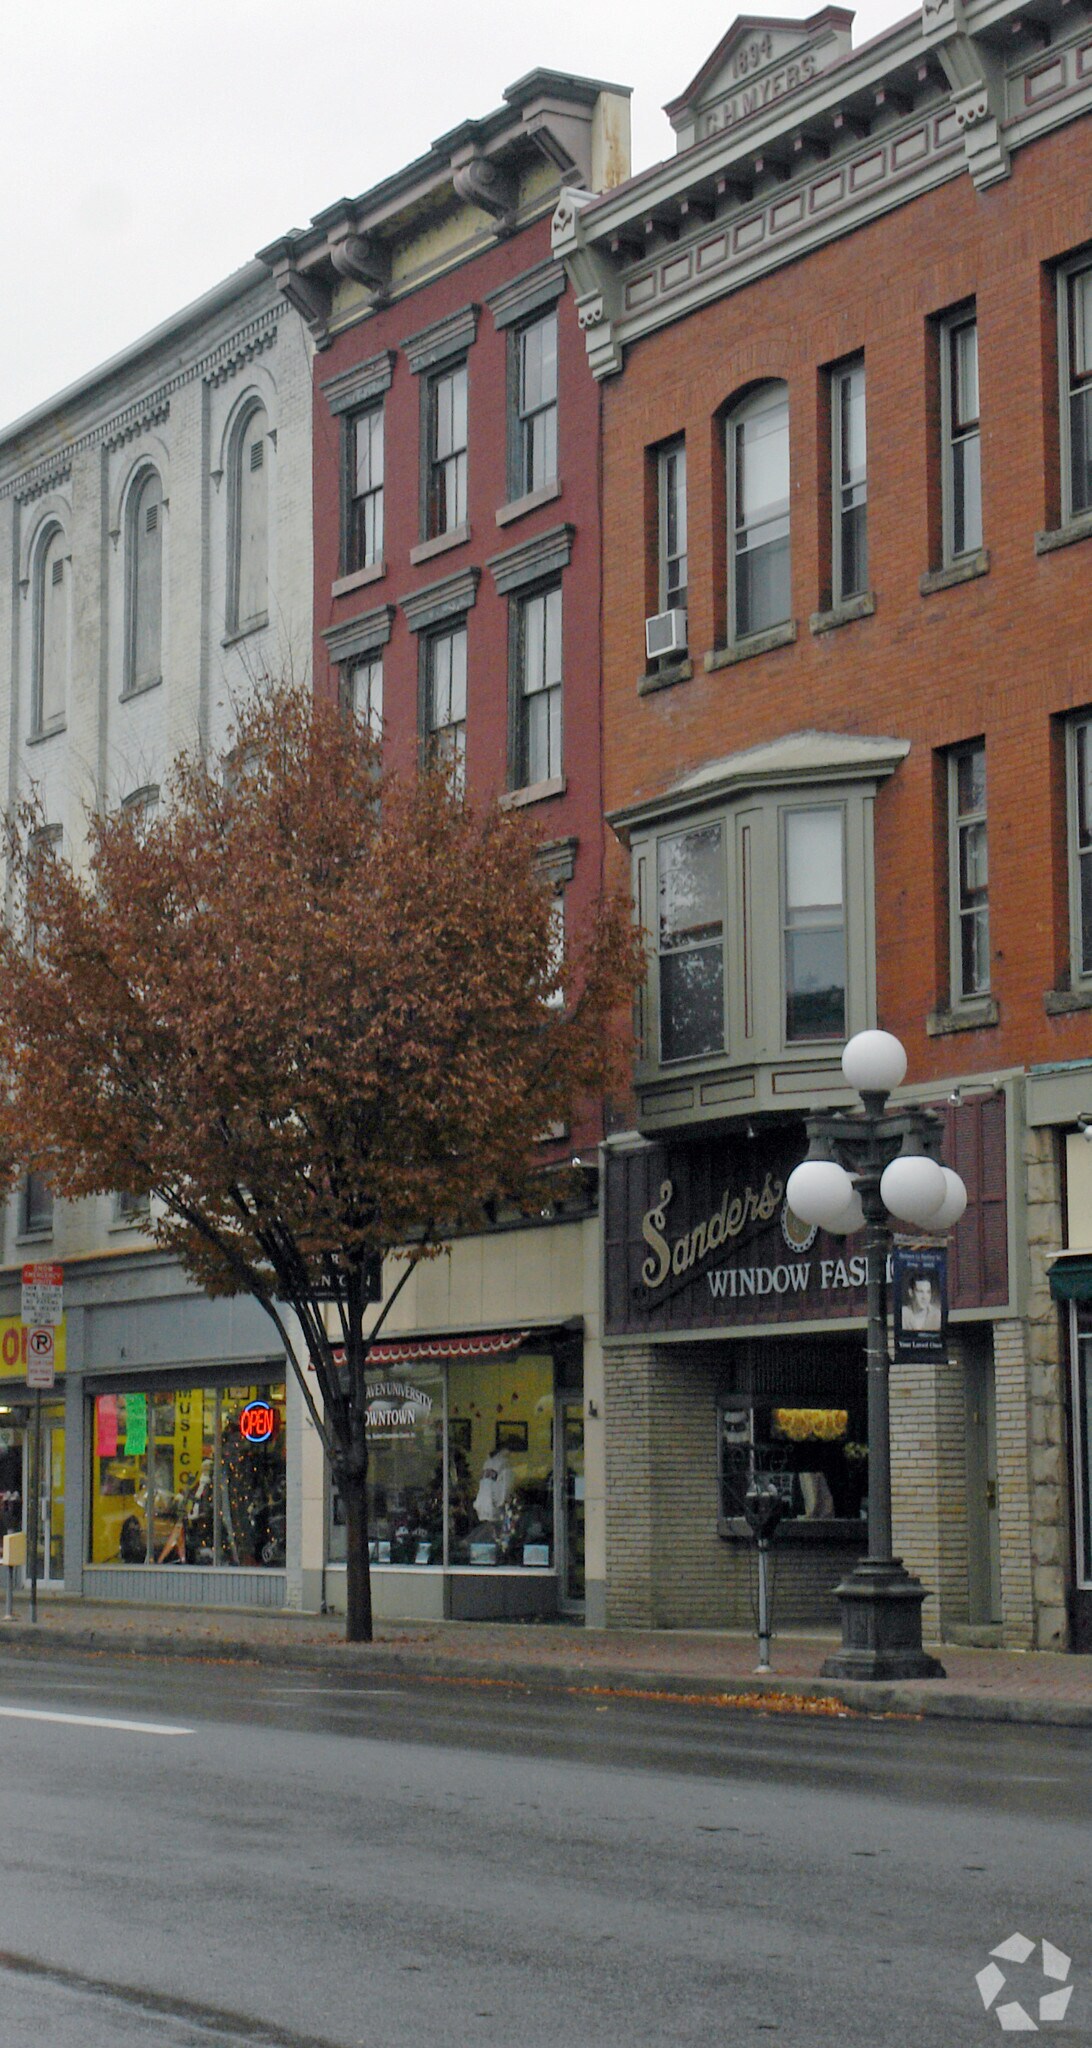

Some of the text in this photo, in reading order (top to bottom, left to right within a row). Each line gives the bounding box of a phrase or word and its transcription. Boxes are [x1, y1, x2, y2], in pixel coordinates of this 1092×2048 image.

[732, 33, 772, 79] 1894
[743, 55, 815, 114] MYERS
[642, 1172, 783, 1288] Sanders
[707, 1262, 811, 1297] WINDOW
[387, 1382, 433, 1411] UNIVERSITY
[241, 1408, 274, 1437] OPEN
[364, 1409, 415, 1427] OWNTOWN
